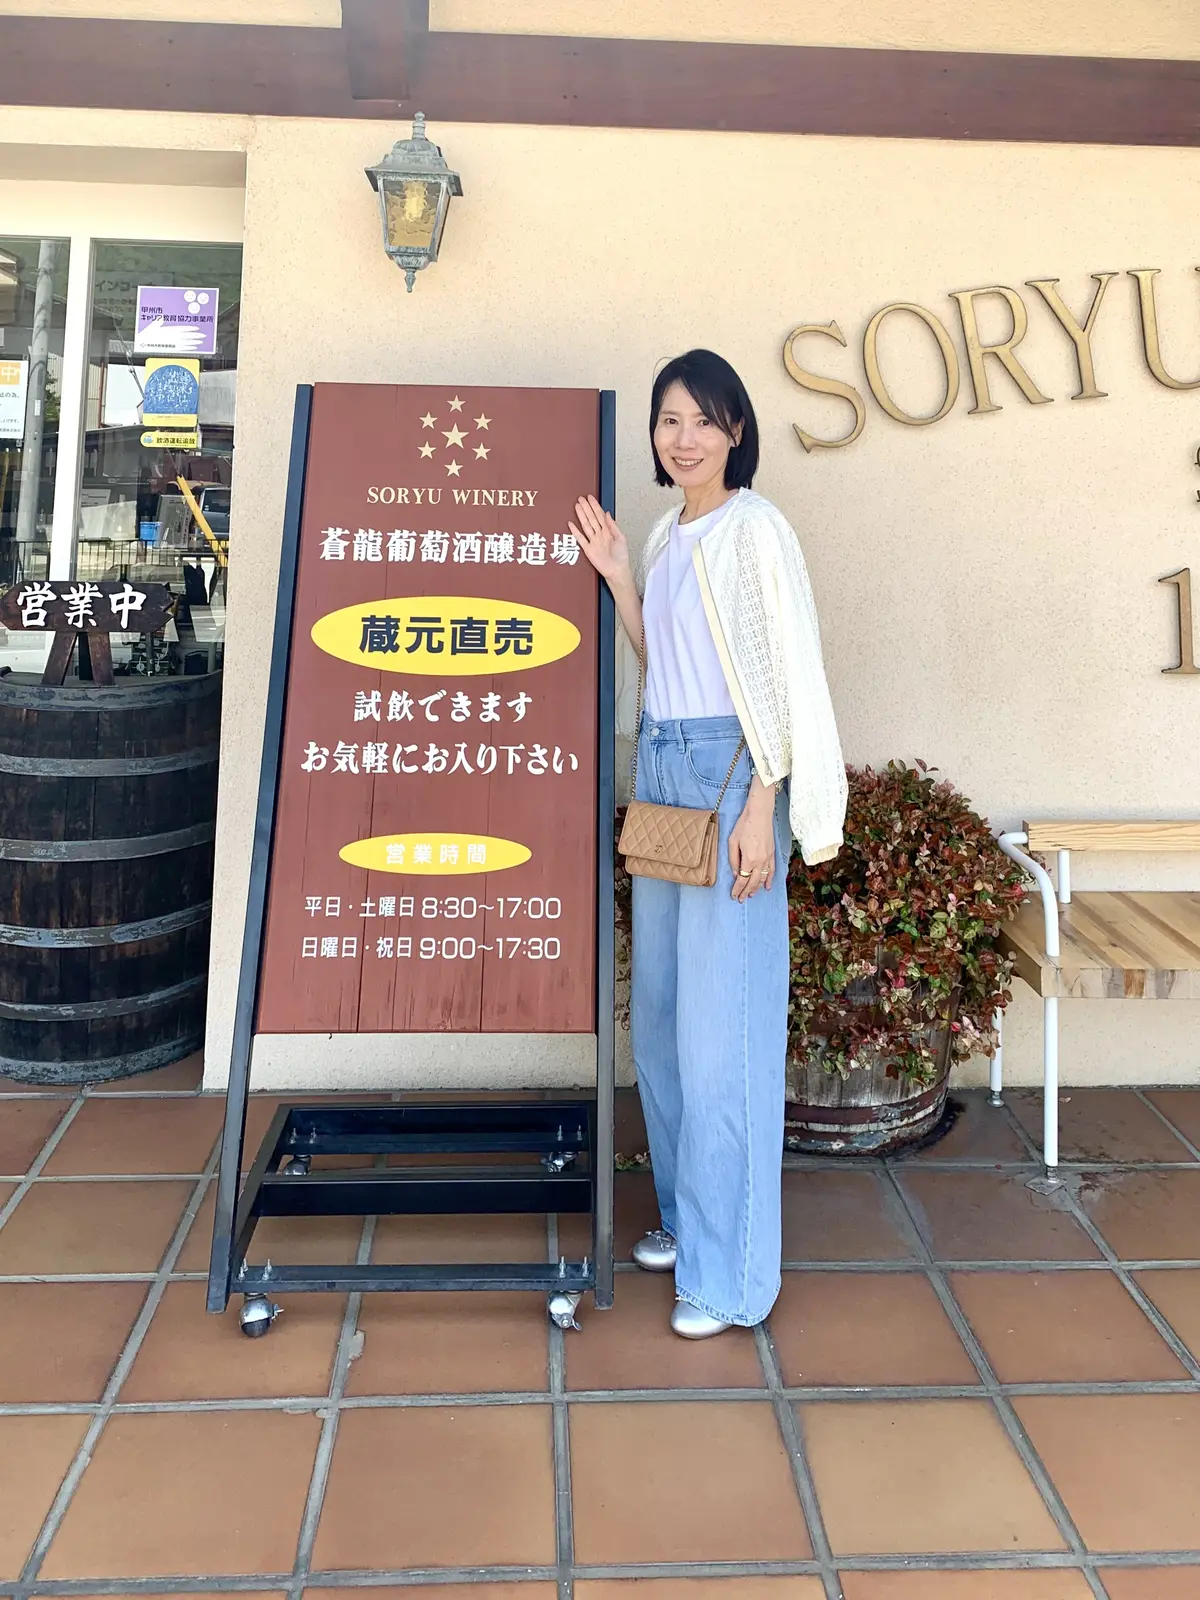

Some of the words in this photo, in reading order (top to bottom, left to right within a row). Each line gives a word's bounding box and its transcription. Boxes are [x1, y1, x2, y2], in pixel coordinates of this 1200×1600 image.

[140, 314, 214, 324] キャリア教育協力事業所
[141, 306, 163, 314] 甲州市
[782, 266, 1200, 455] SORYU
[367, 486, 443, 504] SORYU
[452, 489, 539, 507] WINERY
[17, 581, 147, 629] 営業中
[359, 615, 533, 656] 蔵元直売
[353, 689, 533, 723] 試飲できます
[300, 741, 579, 775] お気軽にお入り下さい
[385, 844, 487, 865] 営業時間
